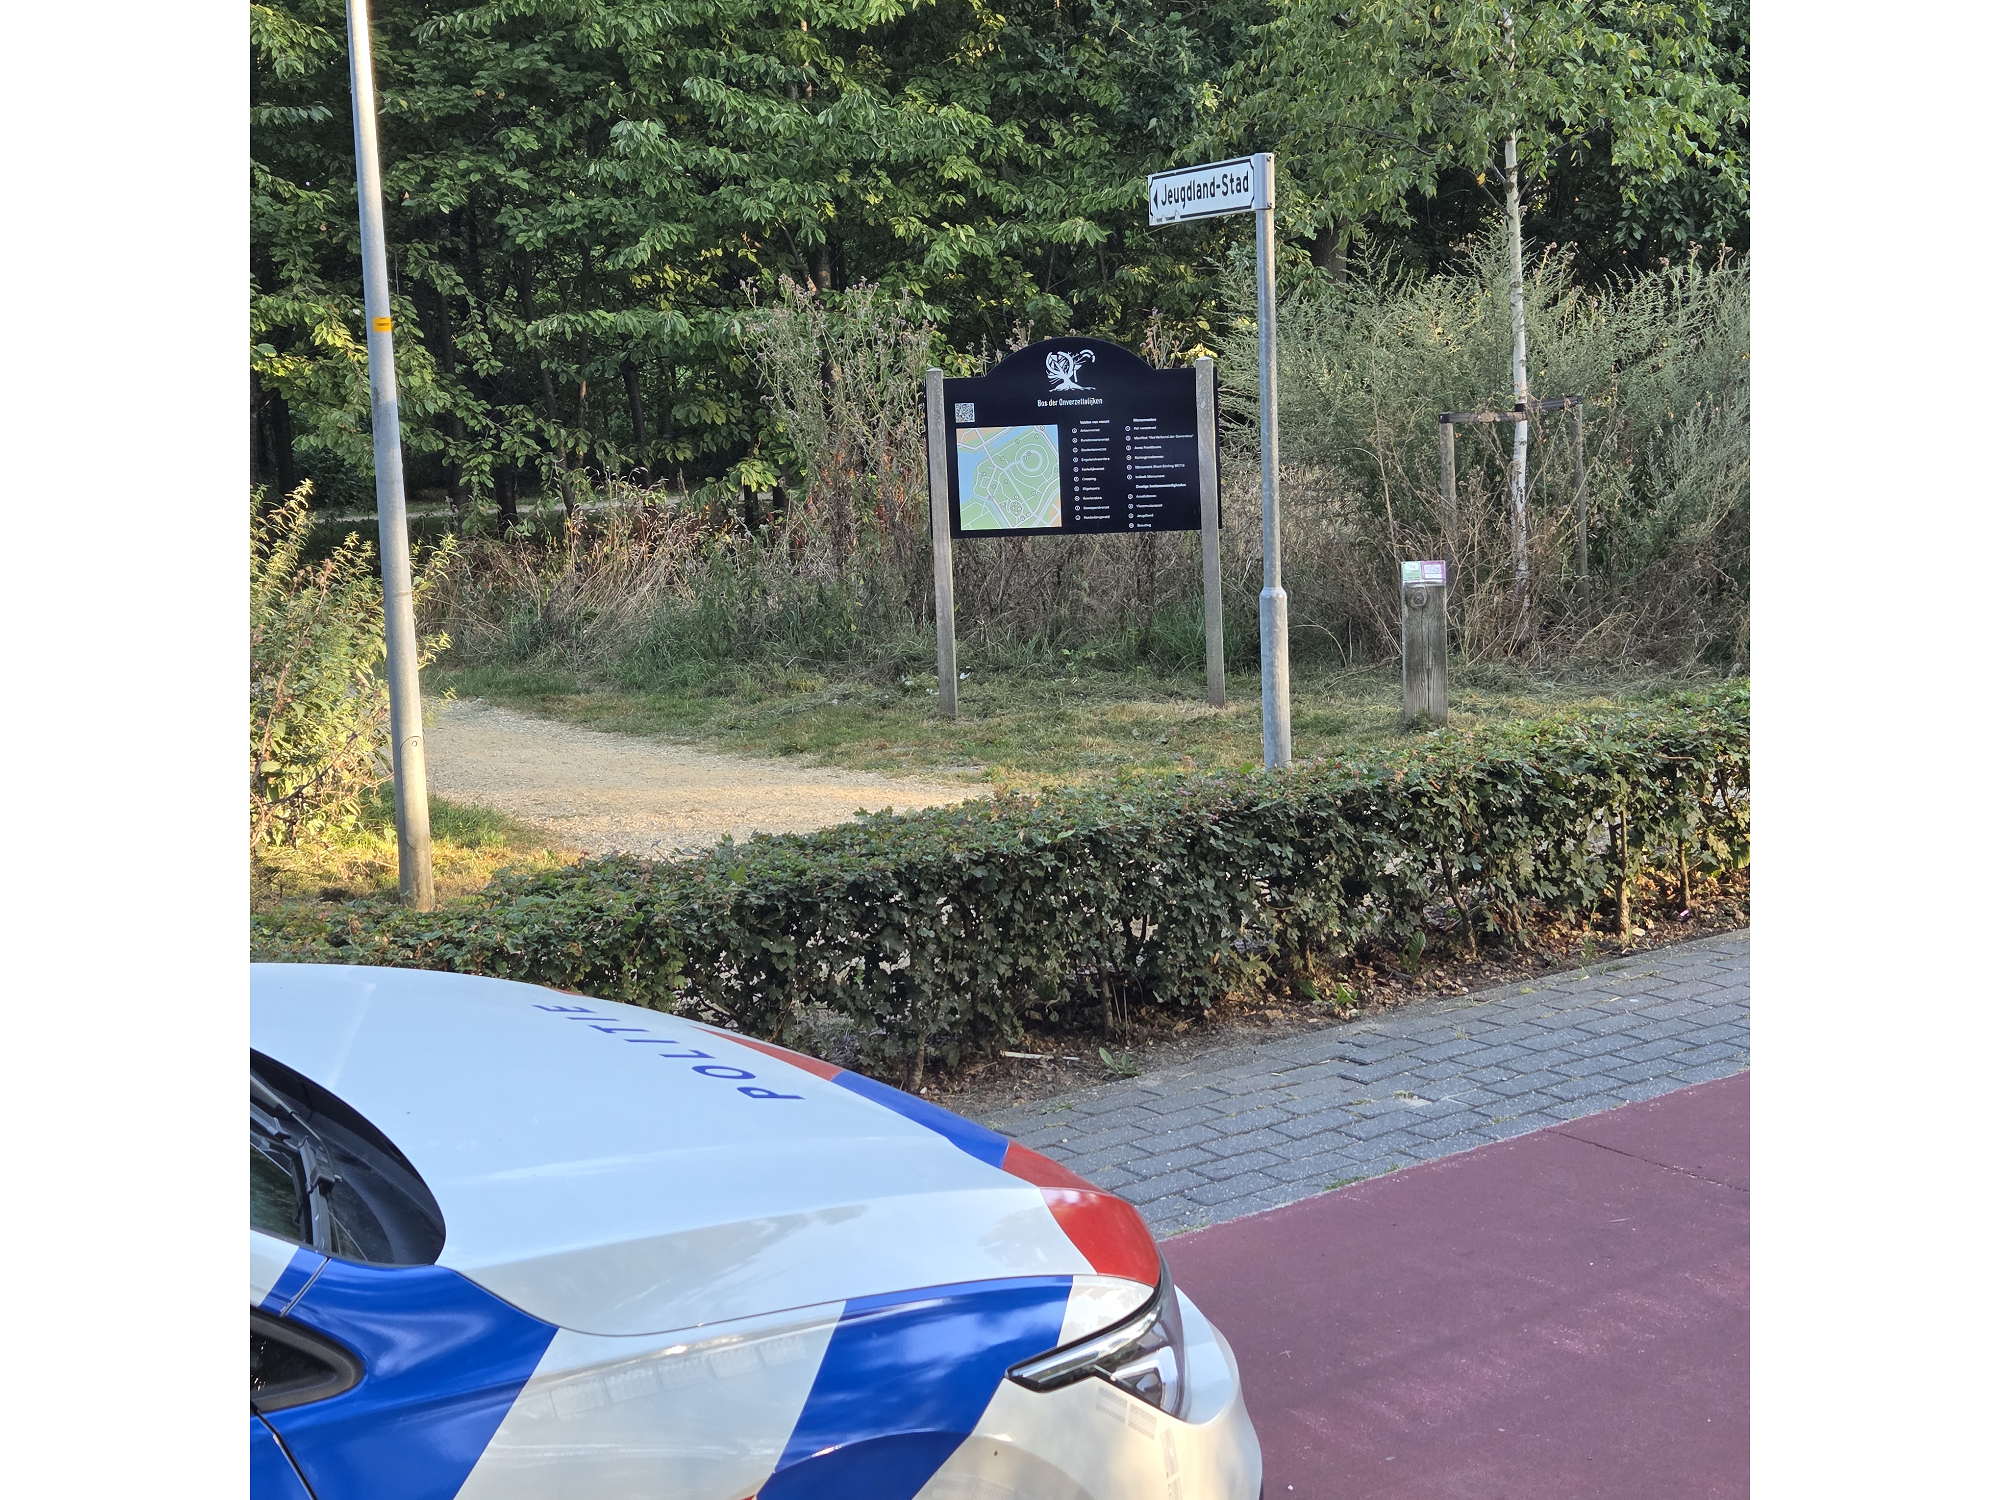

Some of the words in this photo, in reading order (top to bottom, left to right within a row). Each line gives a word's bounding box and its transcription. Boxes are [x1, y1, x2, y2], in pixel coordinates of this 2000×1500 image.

[1161, 170, 1249, 209] Jeugdland-Stad
[1037, 399, 1048, 407] Bos
[1048, 398, 1058, 407] der
[531, 1004, 806, 1100] POLITIE
